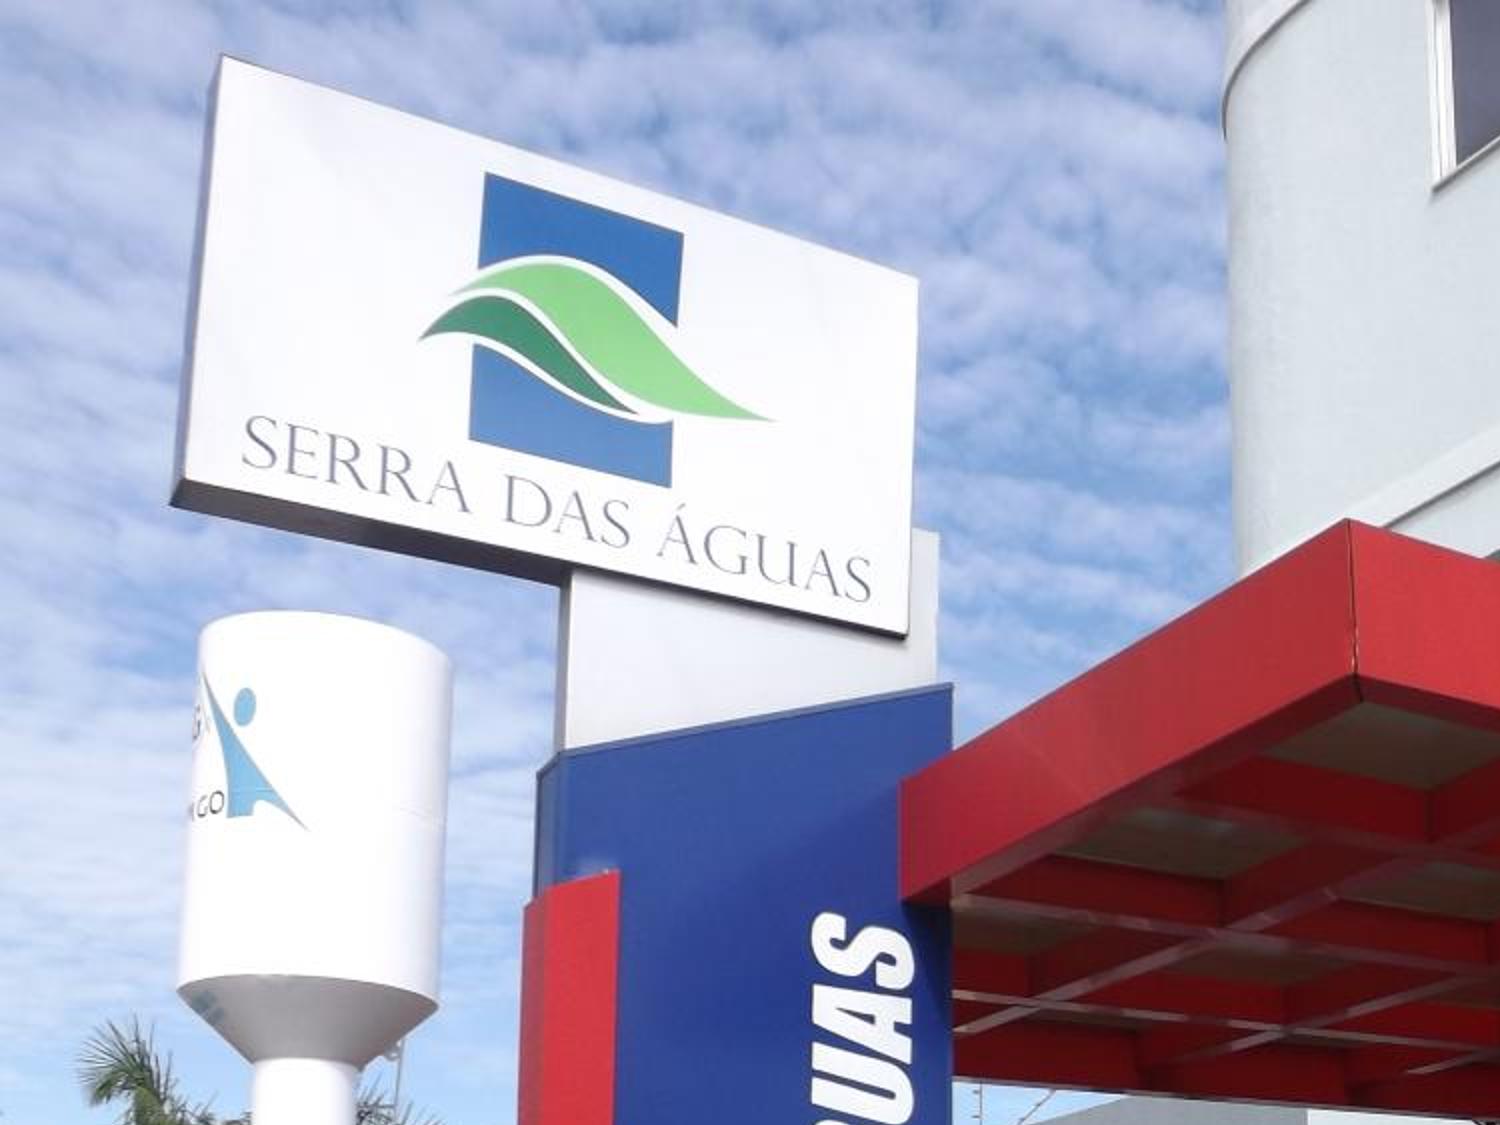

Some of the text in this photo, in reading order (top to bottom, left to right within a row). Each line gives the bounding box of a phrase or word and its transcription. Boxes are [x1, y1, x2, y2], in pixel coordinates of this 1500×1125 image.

[241, 414, 873, 604] SERRA DAS ÁGUAS
